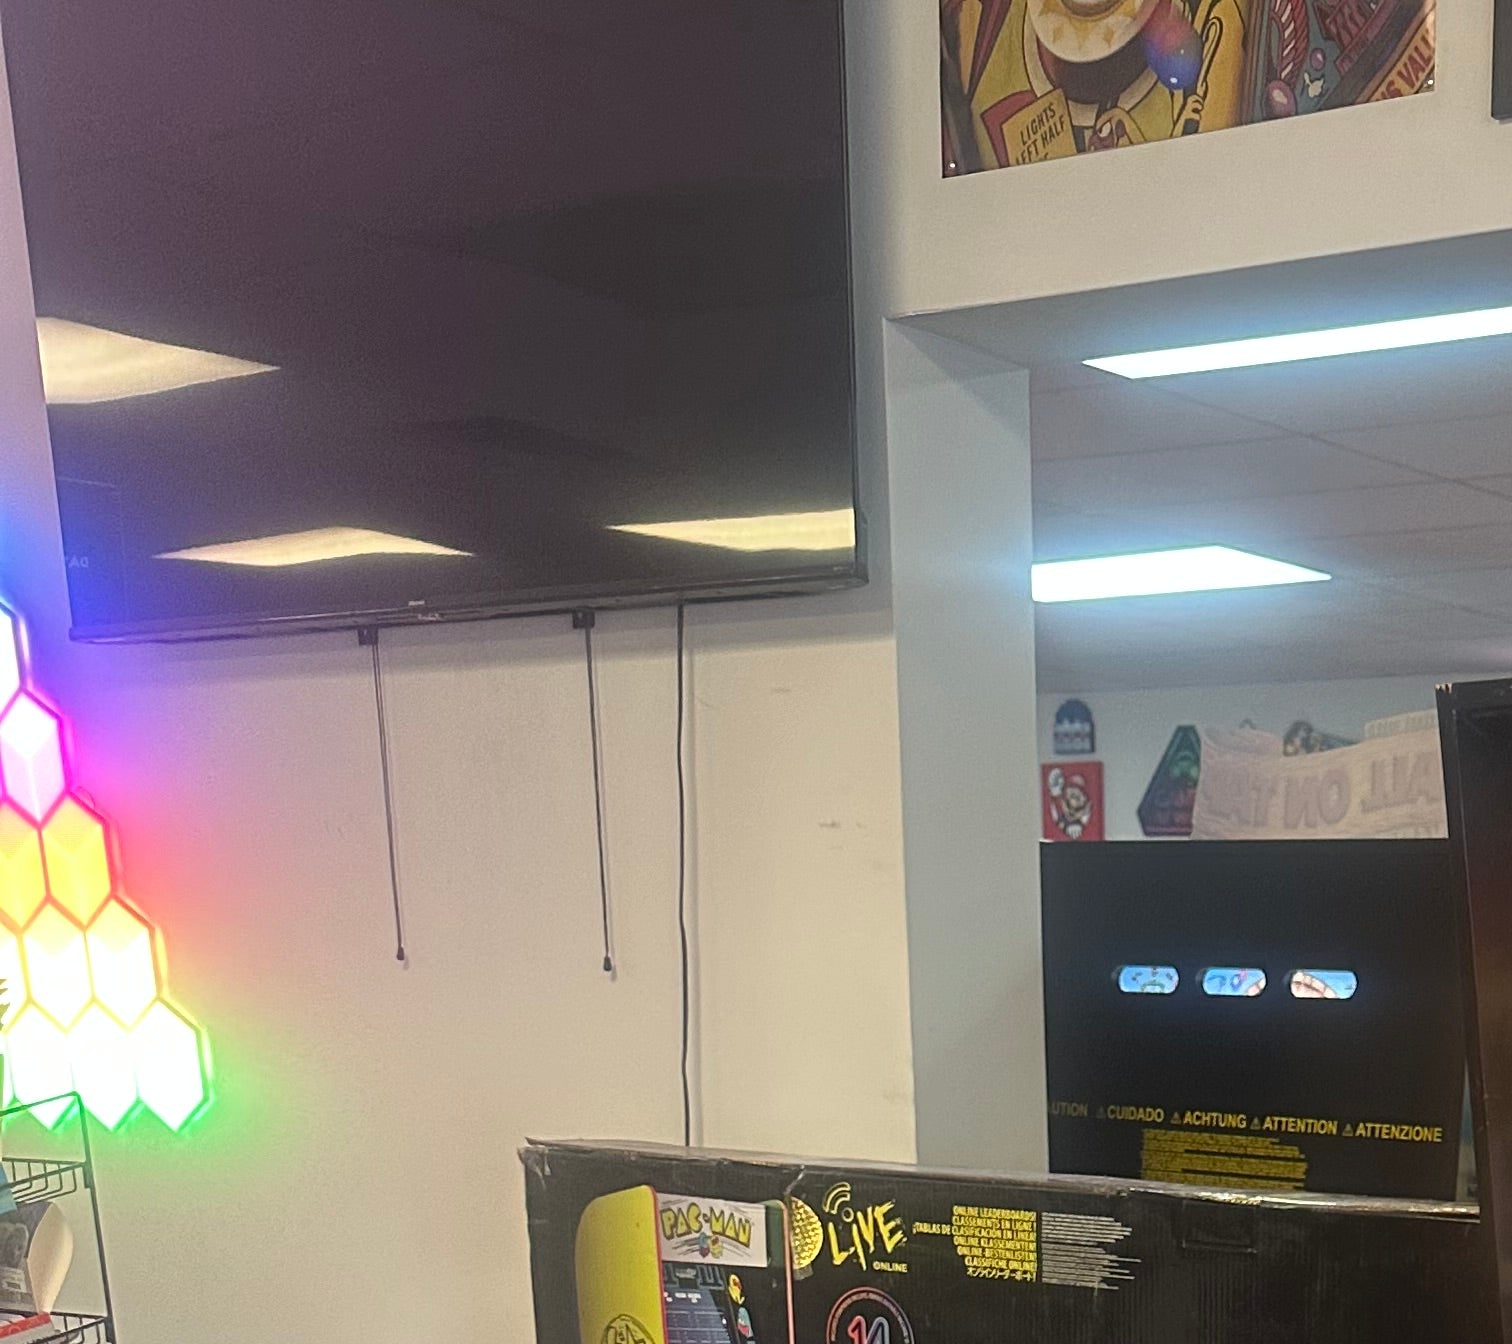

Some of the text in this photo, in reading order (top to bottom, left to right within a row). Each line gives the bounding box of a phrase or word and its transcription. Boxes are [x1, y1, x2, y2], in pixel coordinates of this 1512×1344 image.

[1020, 102, 1056, 146] LIGHTS
[1040, 115, 1065, 149] HALF
[1107, 1105, 1164, 1123] CUIDADO
[1184, 1110, 1247, 1128] ACHTUNG
[1262, 1116, 1338, 1136] ATTENTION
[1356, 1122, 1443, 1143] ATTENZIONE
[660, 1202, 751, 1248] PAC-MAN
[873, 1260, 908, 1273] ONLINE
